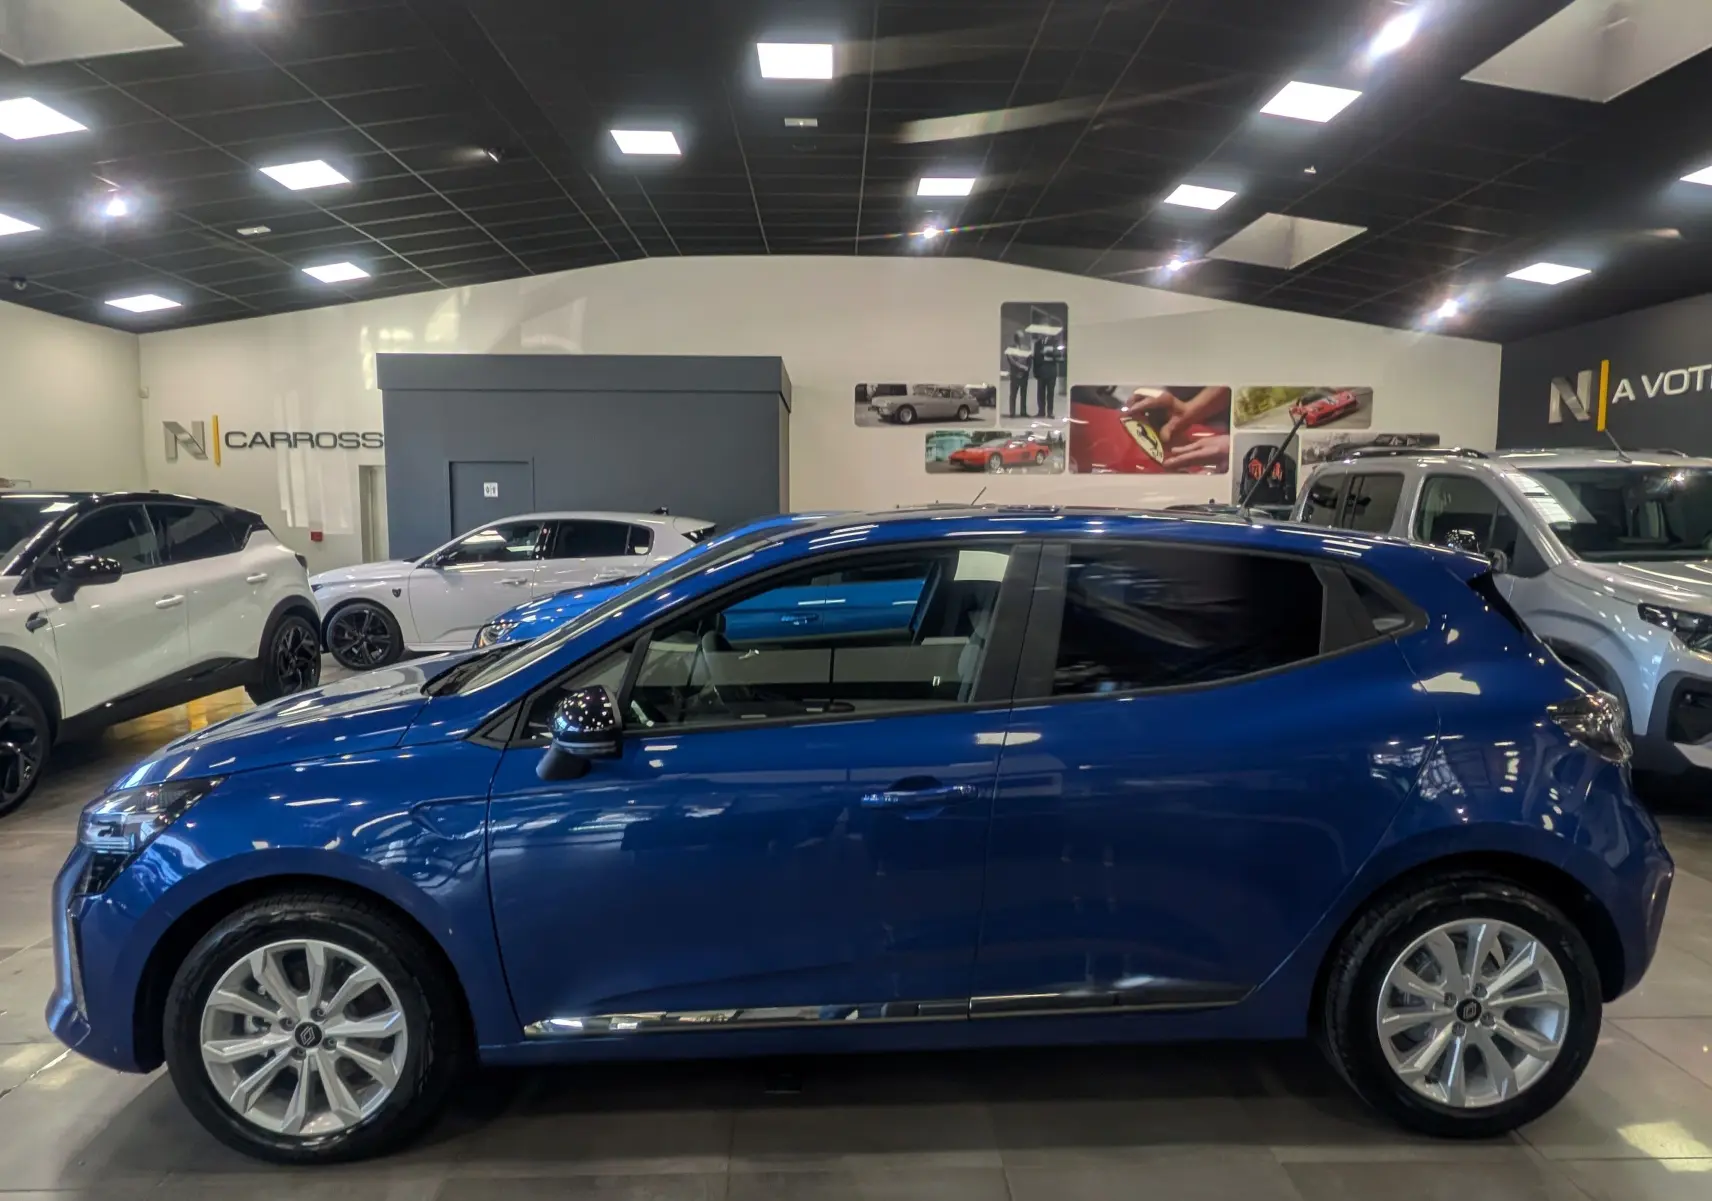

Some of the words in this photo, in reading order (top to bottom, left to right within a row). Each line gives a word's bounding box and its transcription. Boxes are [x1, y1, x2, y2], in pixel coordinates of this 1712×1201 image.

[1612, 378, 1636, 404] A
[1641, 364, 1712, 399] VOT
[224, 431, 384, 449] CARROSS
